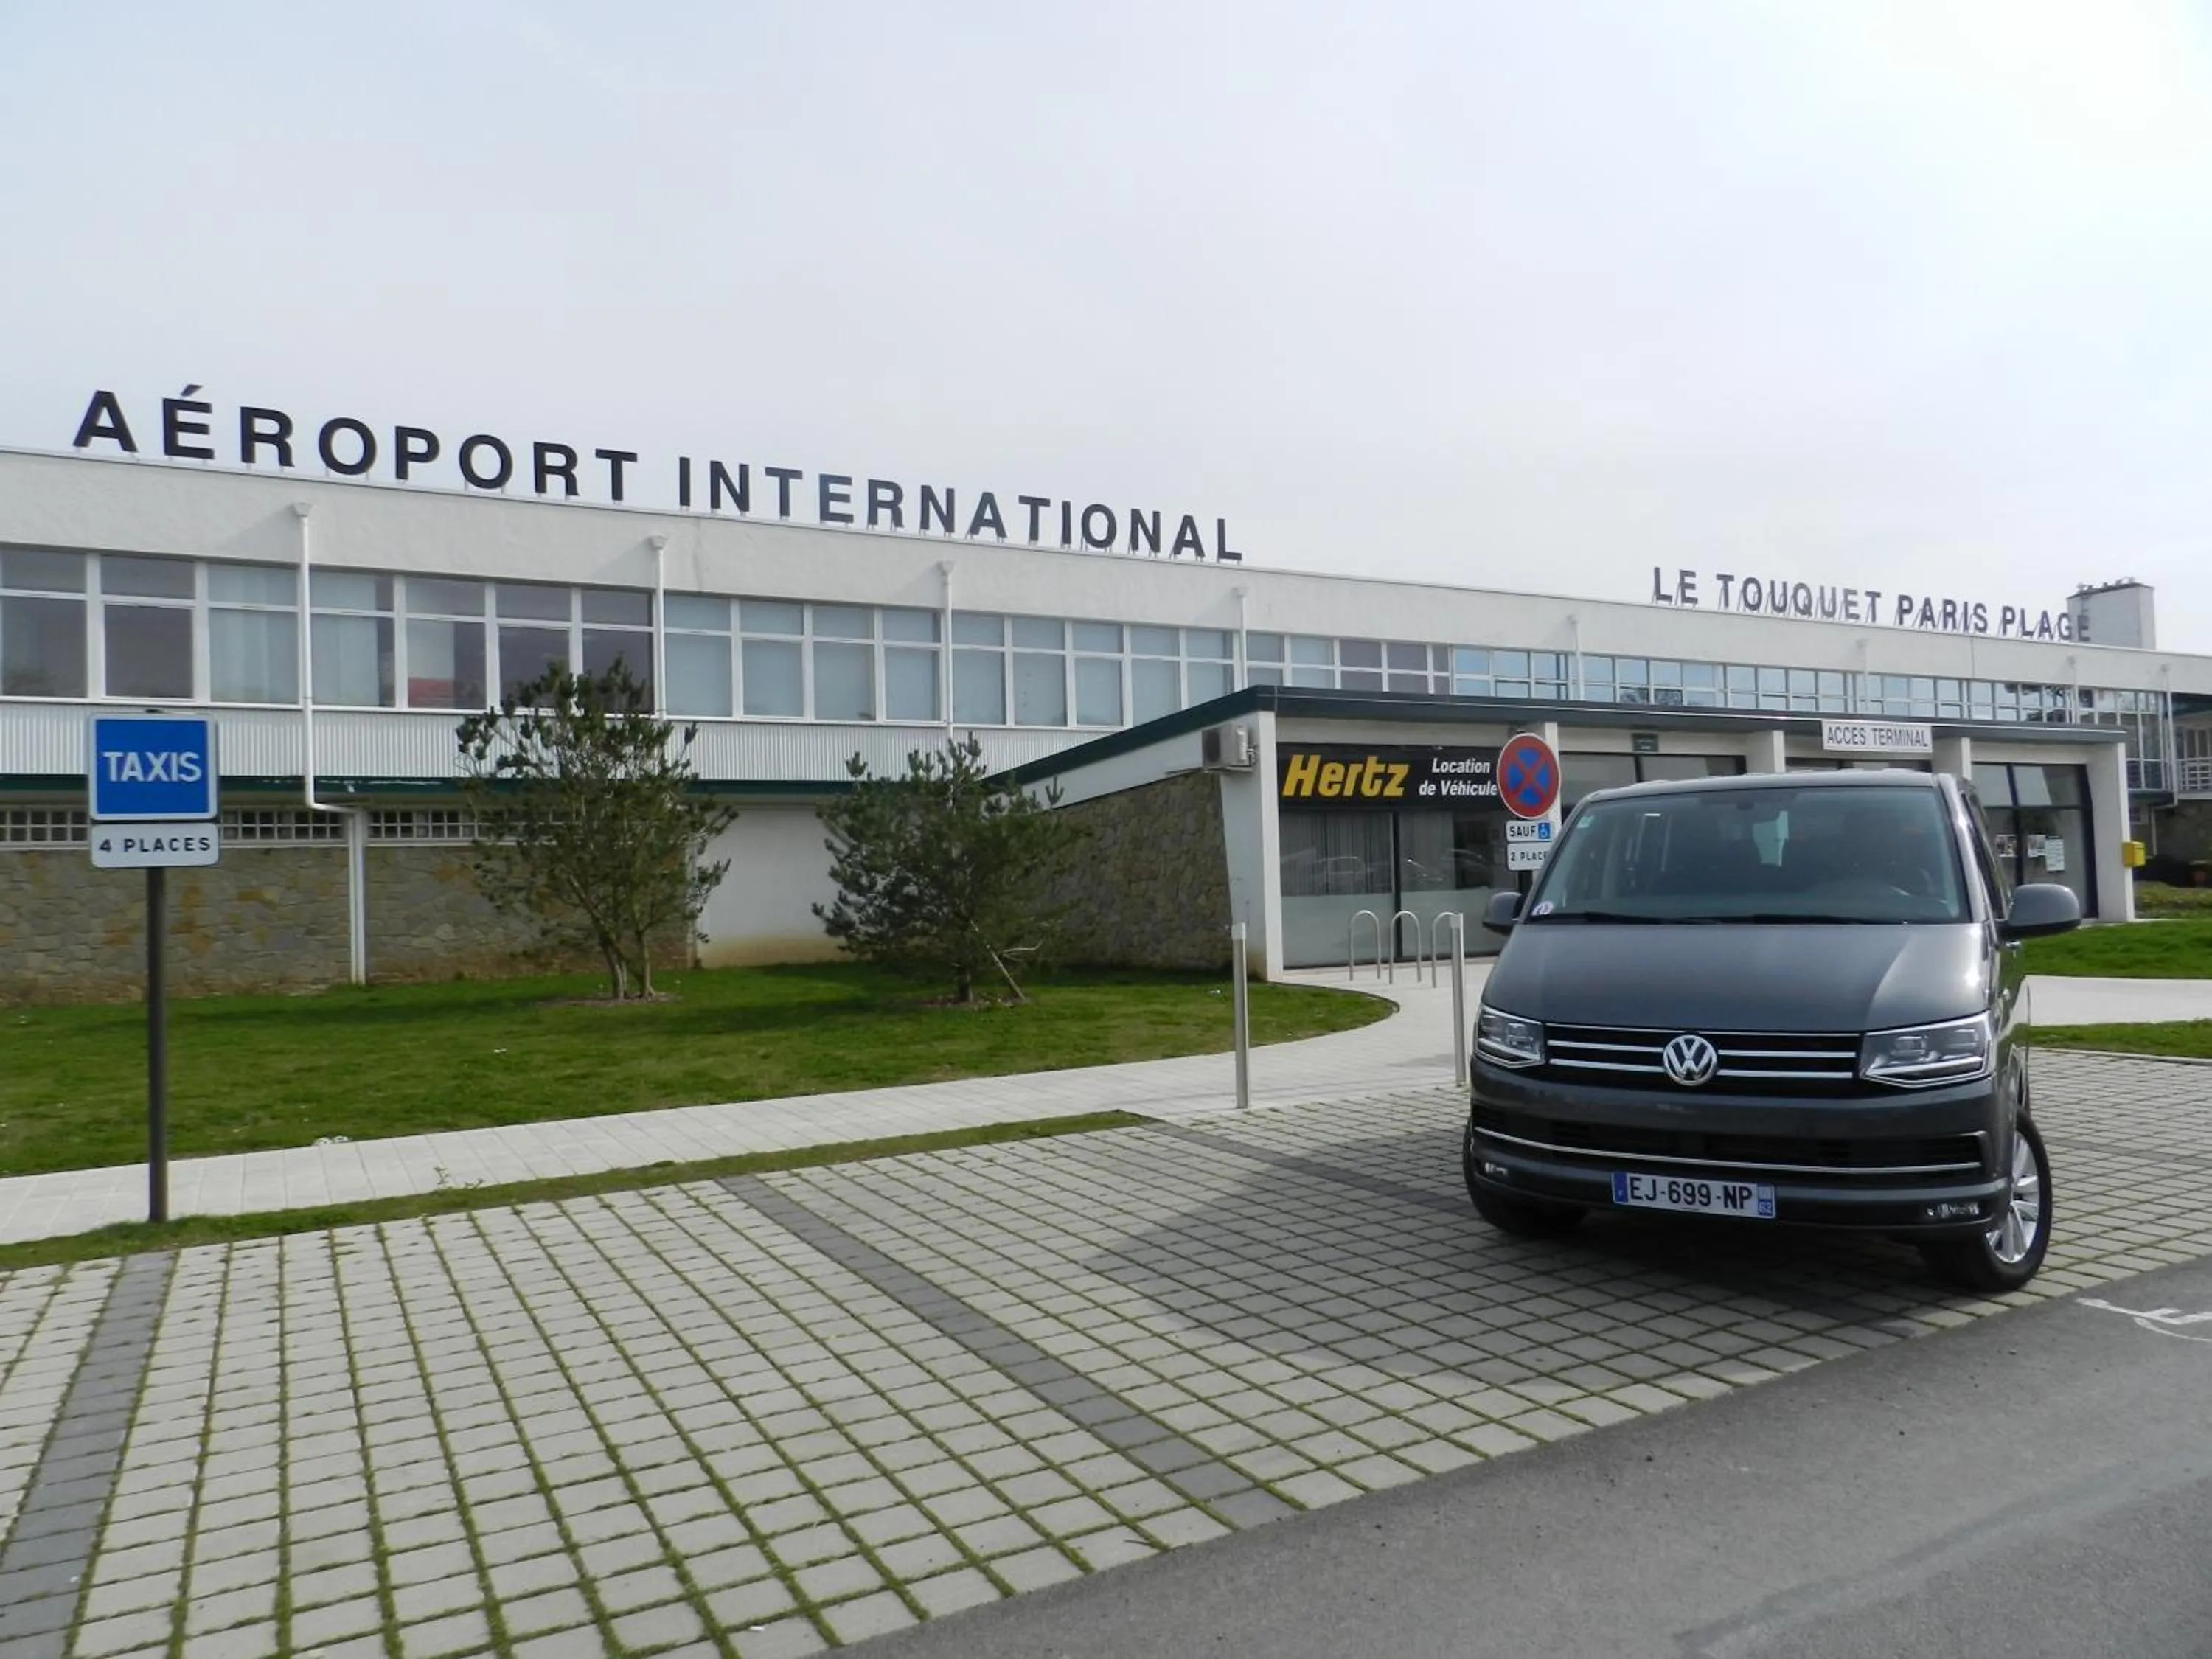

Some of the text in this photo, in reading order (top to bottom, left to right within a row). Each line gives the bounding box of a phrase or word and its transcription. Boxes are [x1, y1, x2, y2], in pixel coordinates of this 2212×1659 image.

[73, 384, 1243, 563] AÉROPORT INTERNATIONAL
[1653, 566, 2091, 642] LE TOUQUET PARIS PLAGE
[1871, 728, 1929, 748] TERMINAL
[102, 751, 202, 782] TAXIS
[1431, 757, 1491, 773] Location
[1281, 754, 1410, 798] Hertz
[1419, 779, 1436, 796] de
[1509, 825, 1536, 837] SAUF
[99, 837, 211, 853] 4 PLACES
[1511, 851, 1546, 862] 2 PLAC
